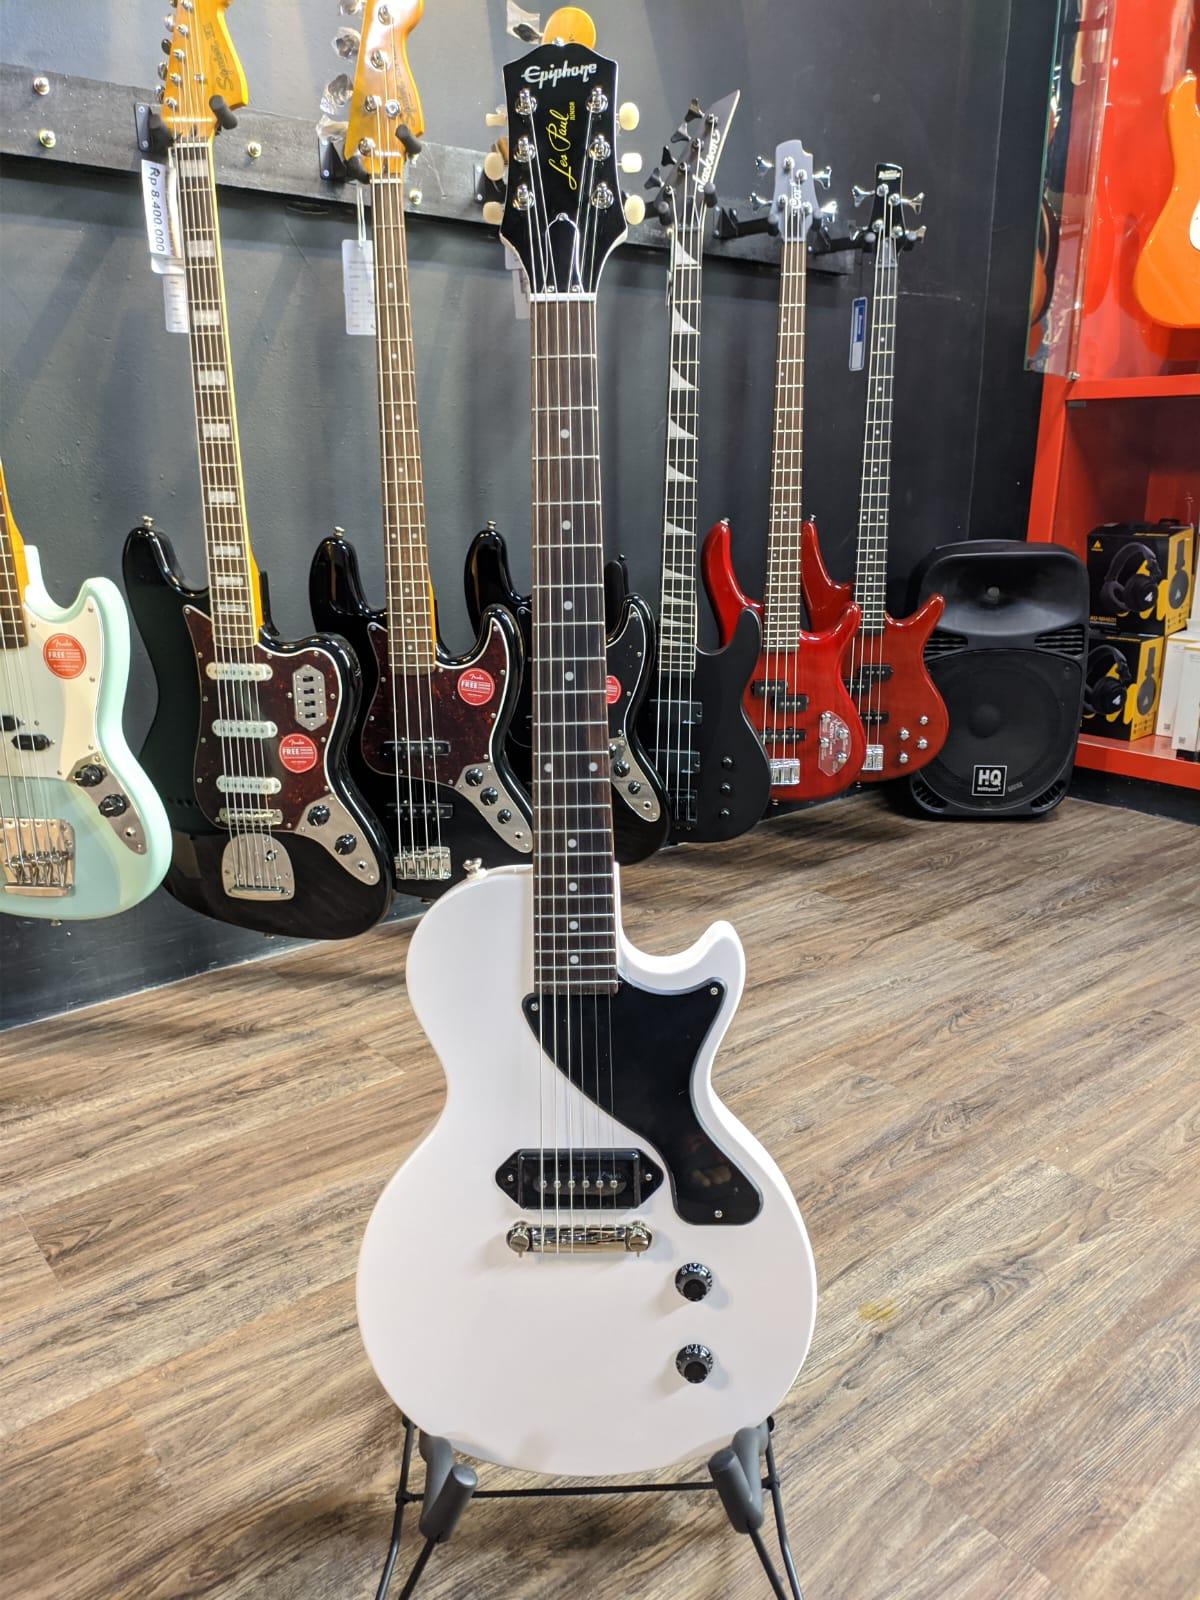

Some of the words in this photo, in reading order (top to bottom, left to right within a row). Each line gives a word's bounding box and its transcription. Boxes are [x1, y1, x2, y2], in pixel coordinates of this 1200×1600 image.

[521, 60, 598, 90] Epiphone
[546, 109, 571, 152] Paul
[148, 166, 161, 187] Rp
[548, 154, 578, 190] Les
[978, 769, 1002, 787] HQ
